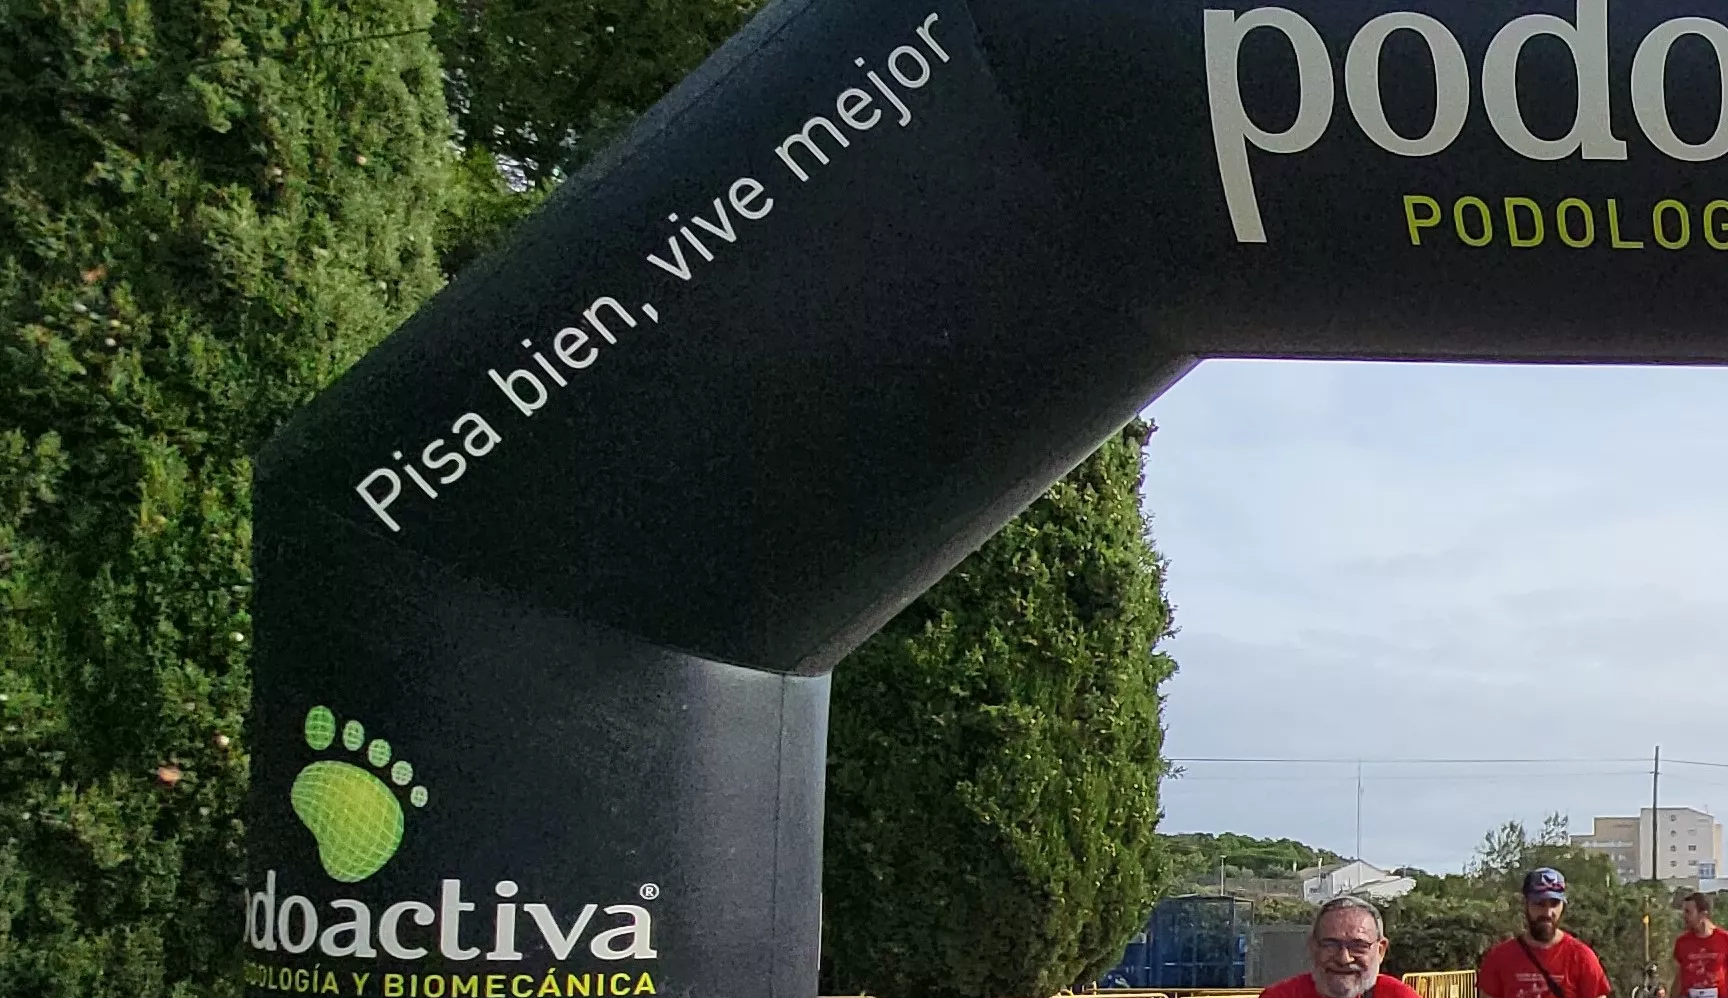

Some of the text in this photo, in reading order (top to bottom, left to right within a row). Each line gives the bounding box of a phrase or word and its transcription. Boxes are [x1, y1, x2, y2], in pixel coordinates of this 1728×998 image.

[356, 12, 950, 531] Pisa bien, vive mejor
[243, 869, 658, 960] doactiva
[352, 972, 370, 996] Y
[384, 968, 657, 998] BIOMECÁNICA
